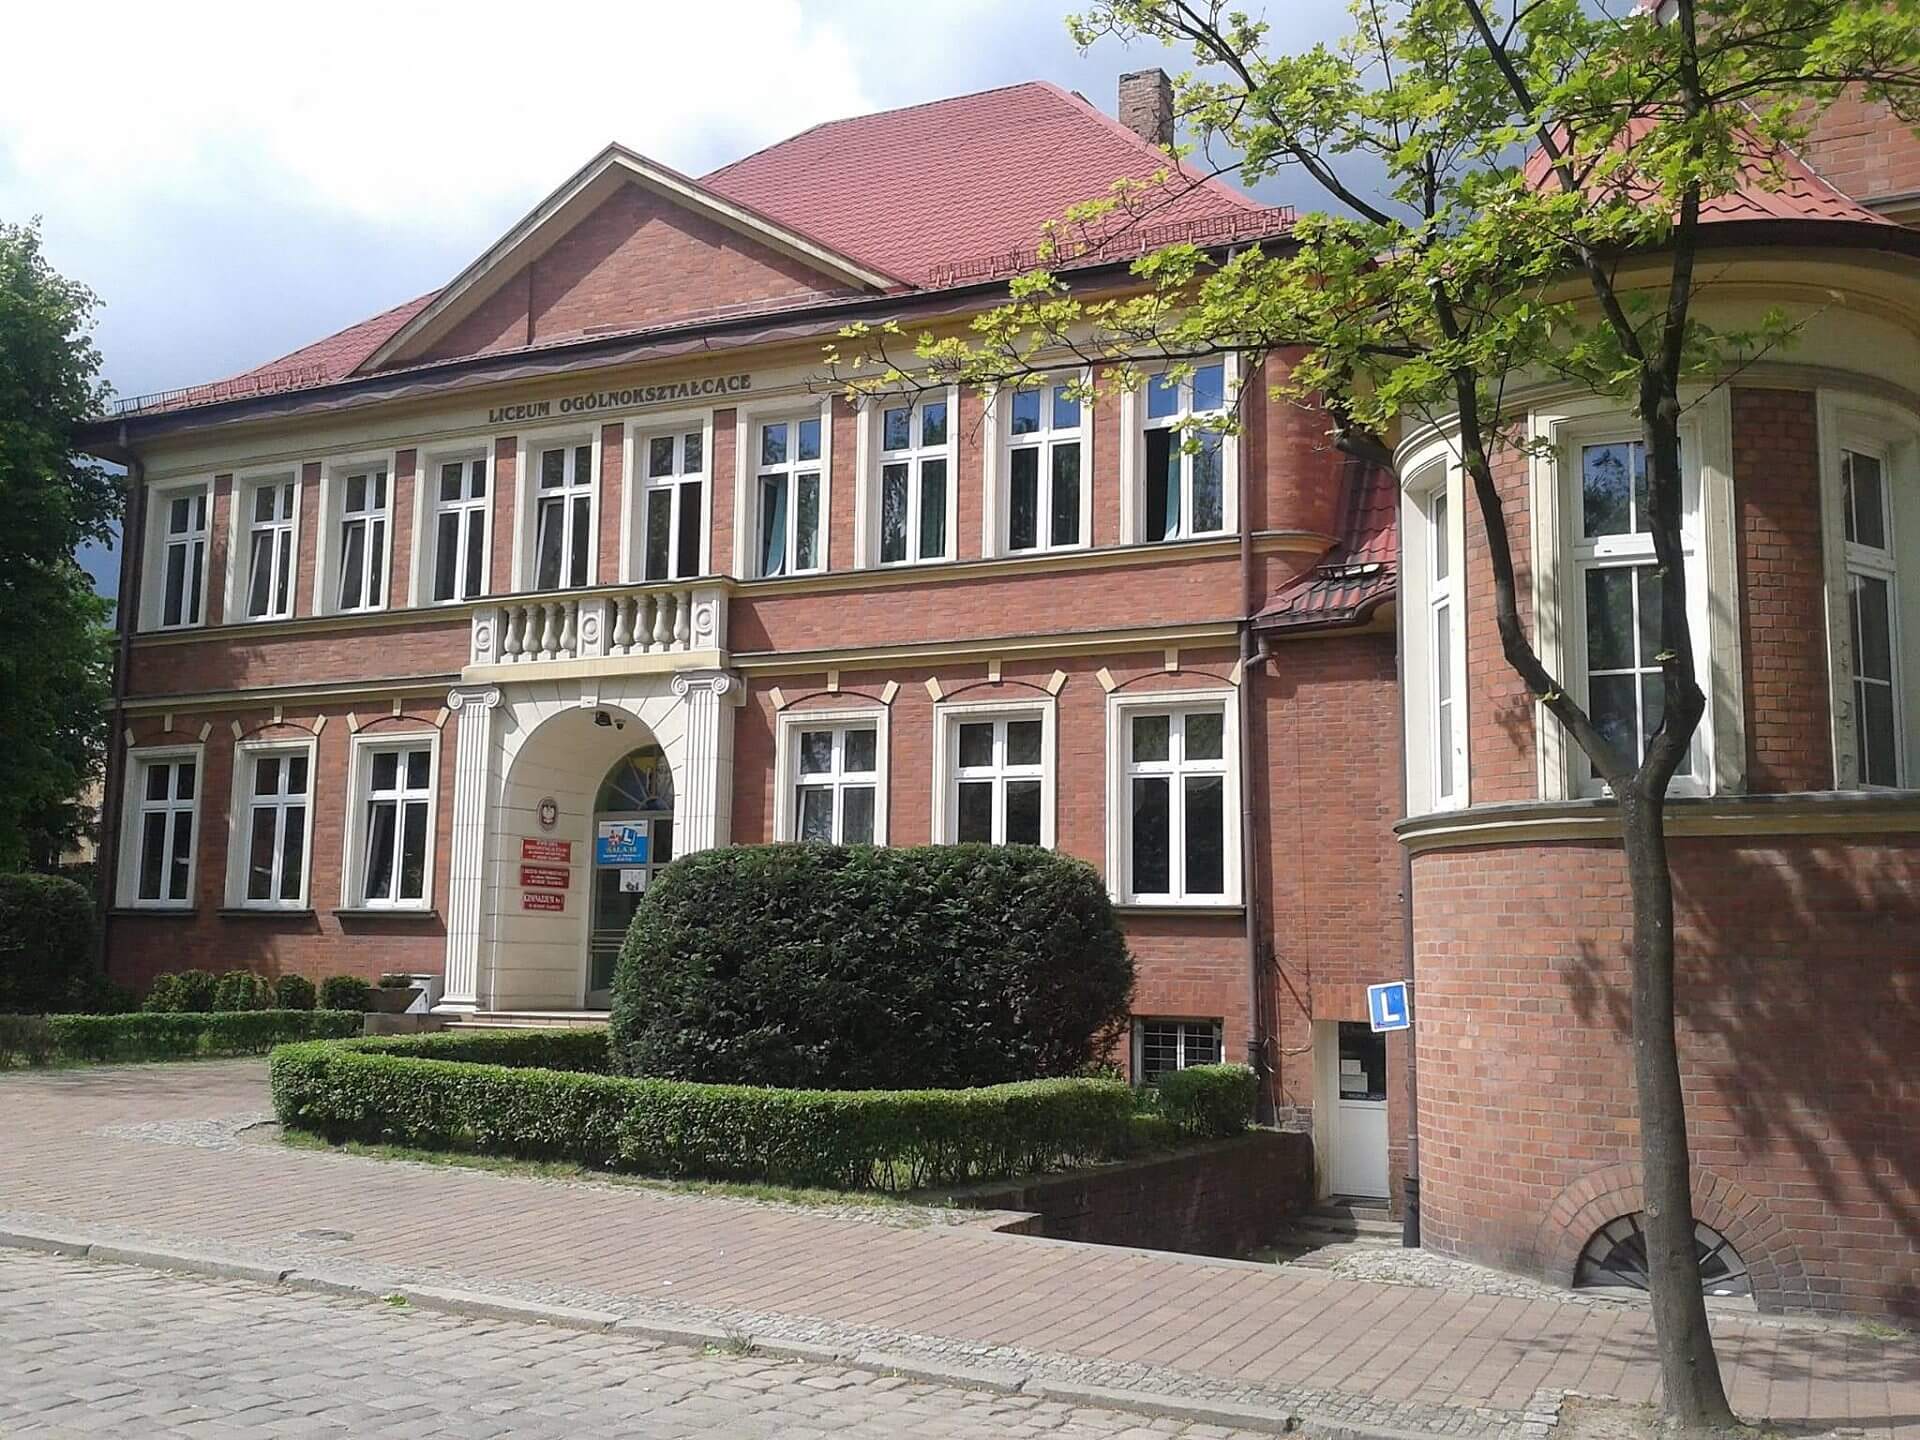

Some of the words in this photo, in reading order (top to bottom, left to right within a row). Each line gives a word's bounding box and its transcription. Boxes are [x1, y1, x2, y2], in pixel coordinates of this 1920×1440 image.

[489, 401, 550, 423] LICEUM
[560, 374, 751, 414] OGÓLNOKSZTAŁCĄCE
[1381, 992, 1400, 1022] L
